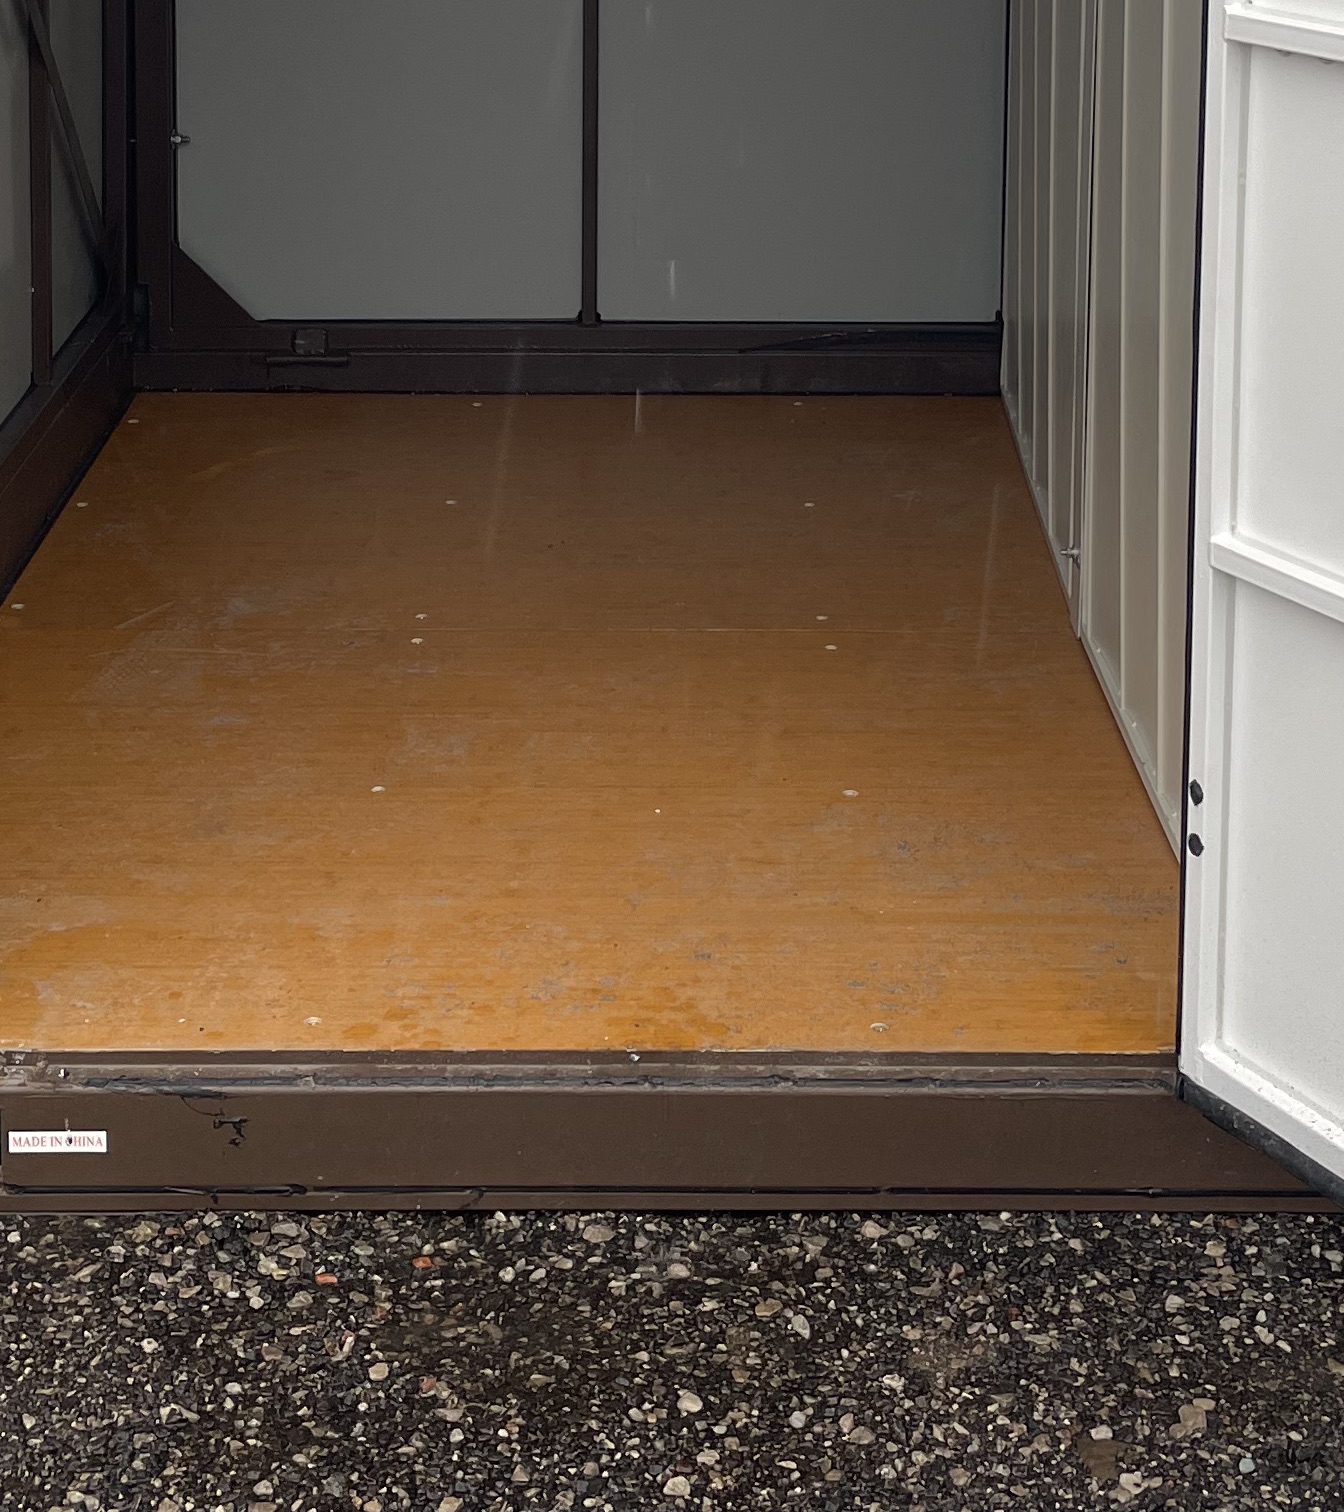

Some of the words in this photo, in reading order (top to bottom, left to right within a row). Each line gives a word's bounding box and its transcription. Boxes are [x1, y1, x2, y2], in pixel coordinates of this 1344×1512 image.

[13, 1136, 47, 1147] MADE
[50, 1136, 62, 1147] IN
[65, 1136, 103, 1147] CHINA
